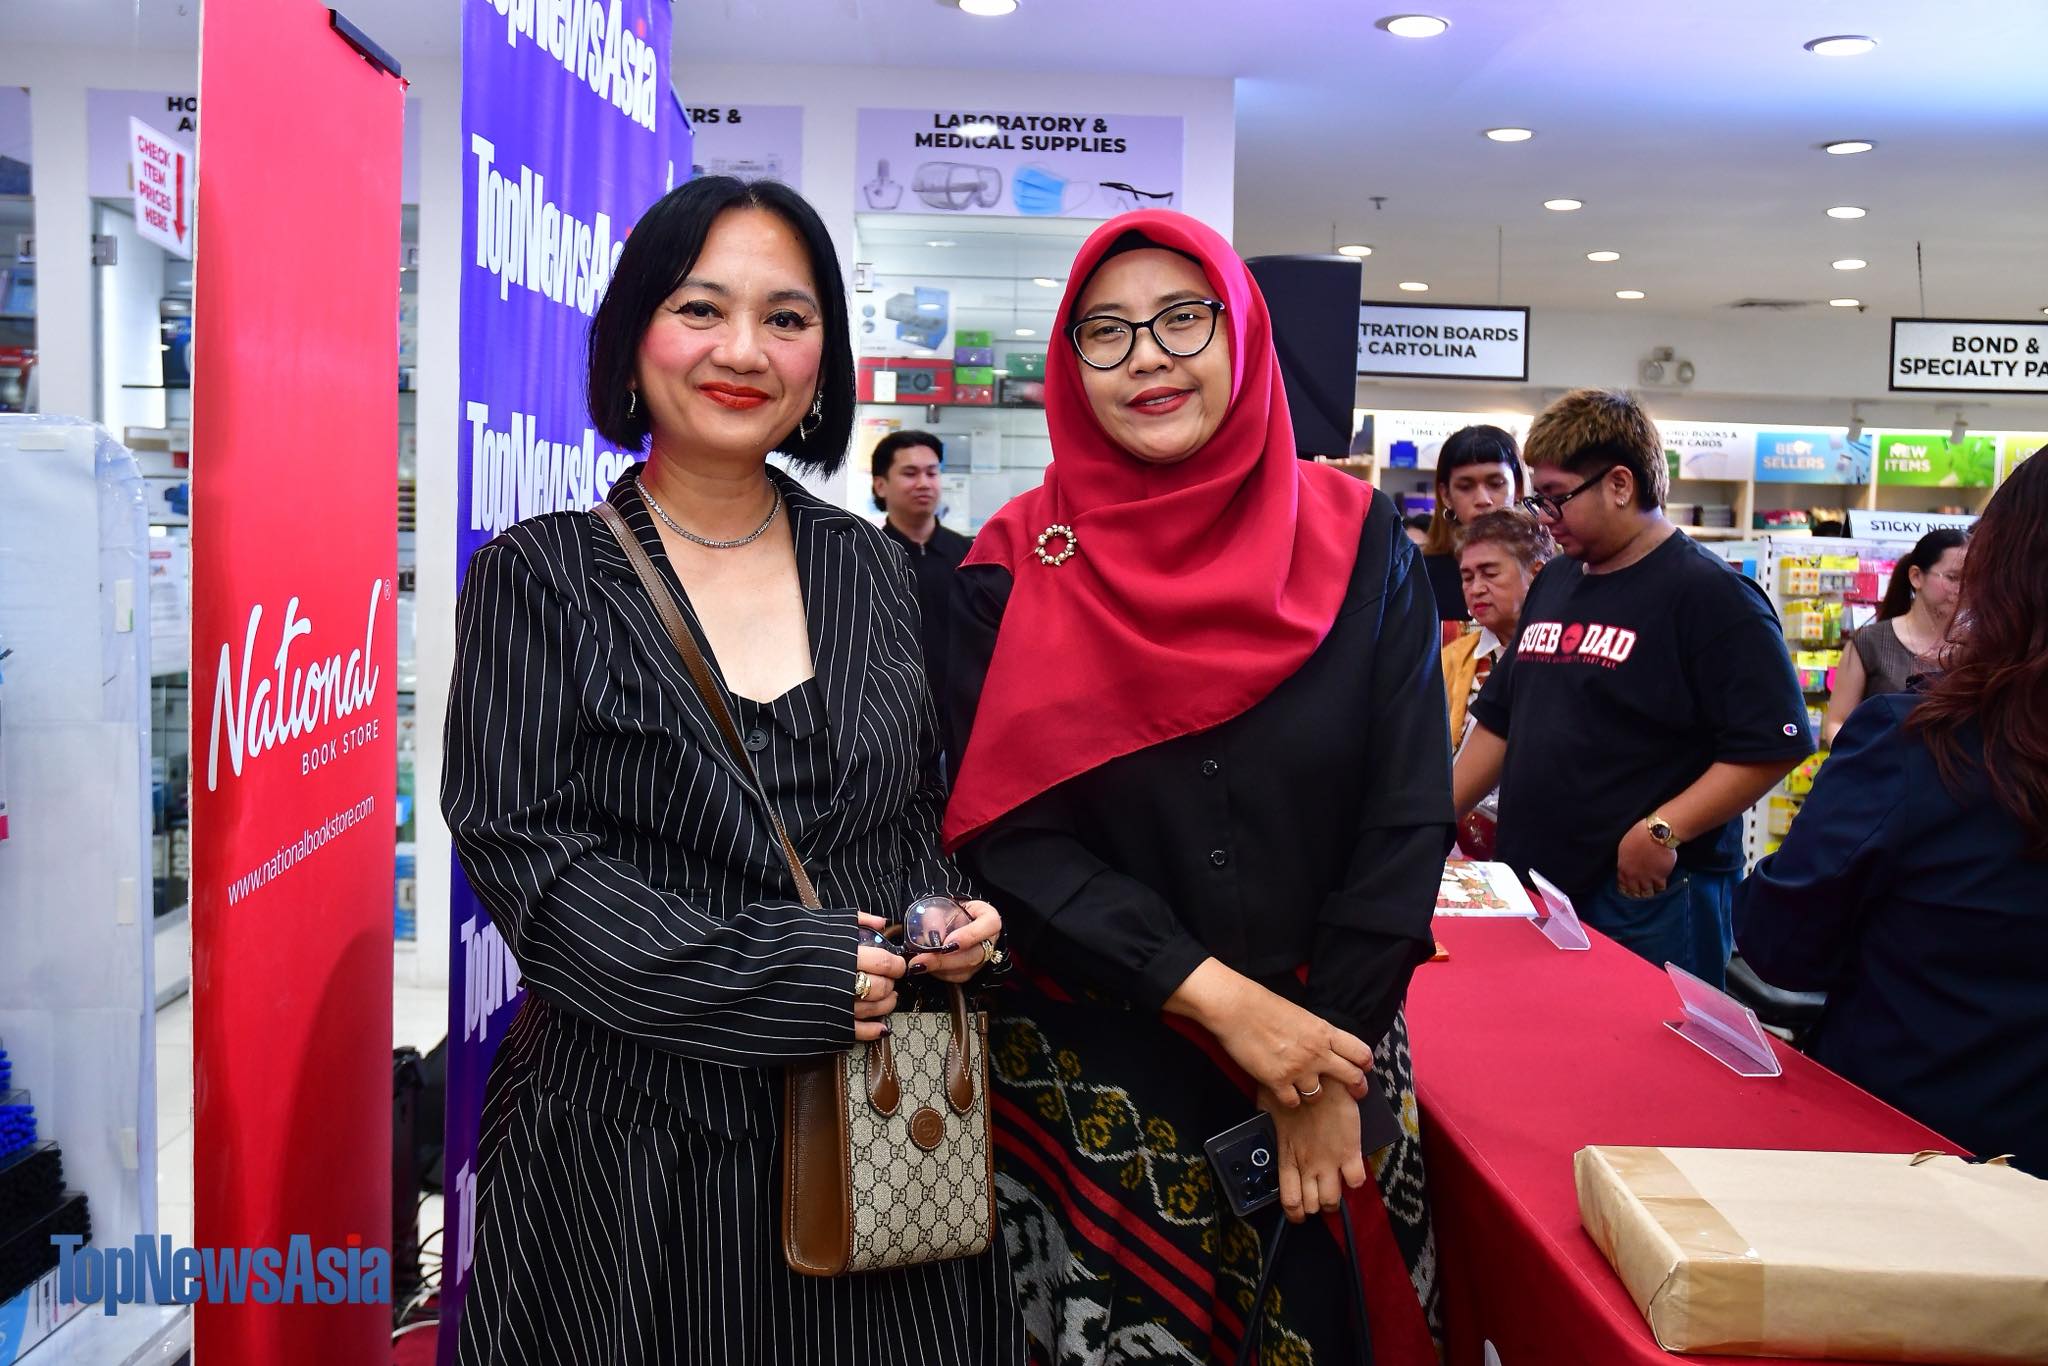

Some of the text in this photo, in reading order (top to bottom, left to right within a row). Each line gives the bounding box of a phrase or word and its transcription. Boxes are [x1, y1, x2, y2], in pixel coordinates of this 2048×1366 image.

[486, 0, 657, 133] ewsAsia
[727, 109, 742, 124] &
[934, 113, 1108, 133] LABORATORY &
[138, 135, 171, 168] CHECK
[915, 133, 1127, 153] MEDICAL SUPPLIES
[143, 160, 166, 187] ITEM
[139, 180, 172, 212] PRICES
[144, 205, 169, 233] HERE
[472, 133, 630, 317] TopNewsA
[1444, 326, 1519, 342] BOARDS
[1368, 341, 1477, 358] CARTOLINA
[1952, 336, 2040, 354] BOND &
[1900, 358, 2018, 377] SPECIALTY
[1688, 440, 1723, 448] CARDS
[1776, 442, 1814, 455] BET
[467, 401, 635, 538] TopNewsAs
[1764, 456, 1825, 470] SELLERS
[1885, 459, 1931, 472] ITEMS
[1871, 520, 1921, 533] STICKY
[1578, 623, 1636, 663] DAD
[208, 578, 382, 792] National
[302, 718, 379, 776] BOOK STORE
[228, 795, 375, 907] www.nationalbookstore.com
